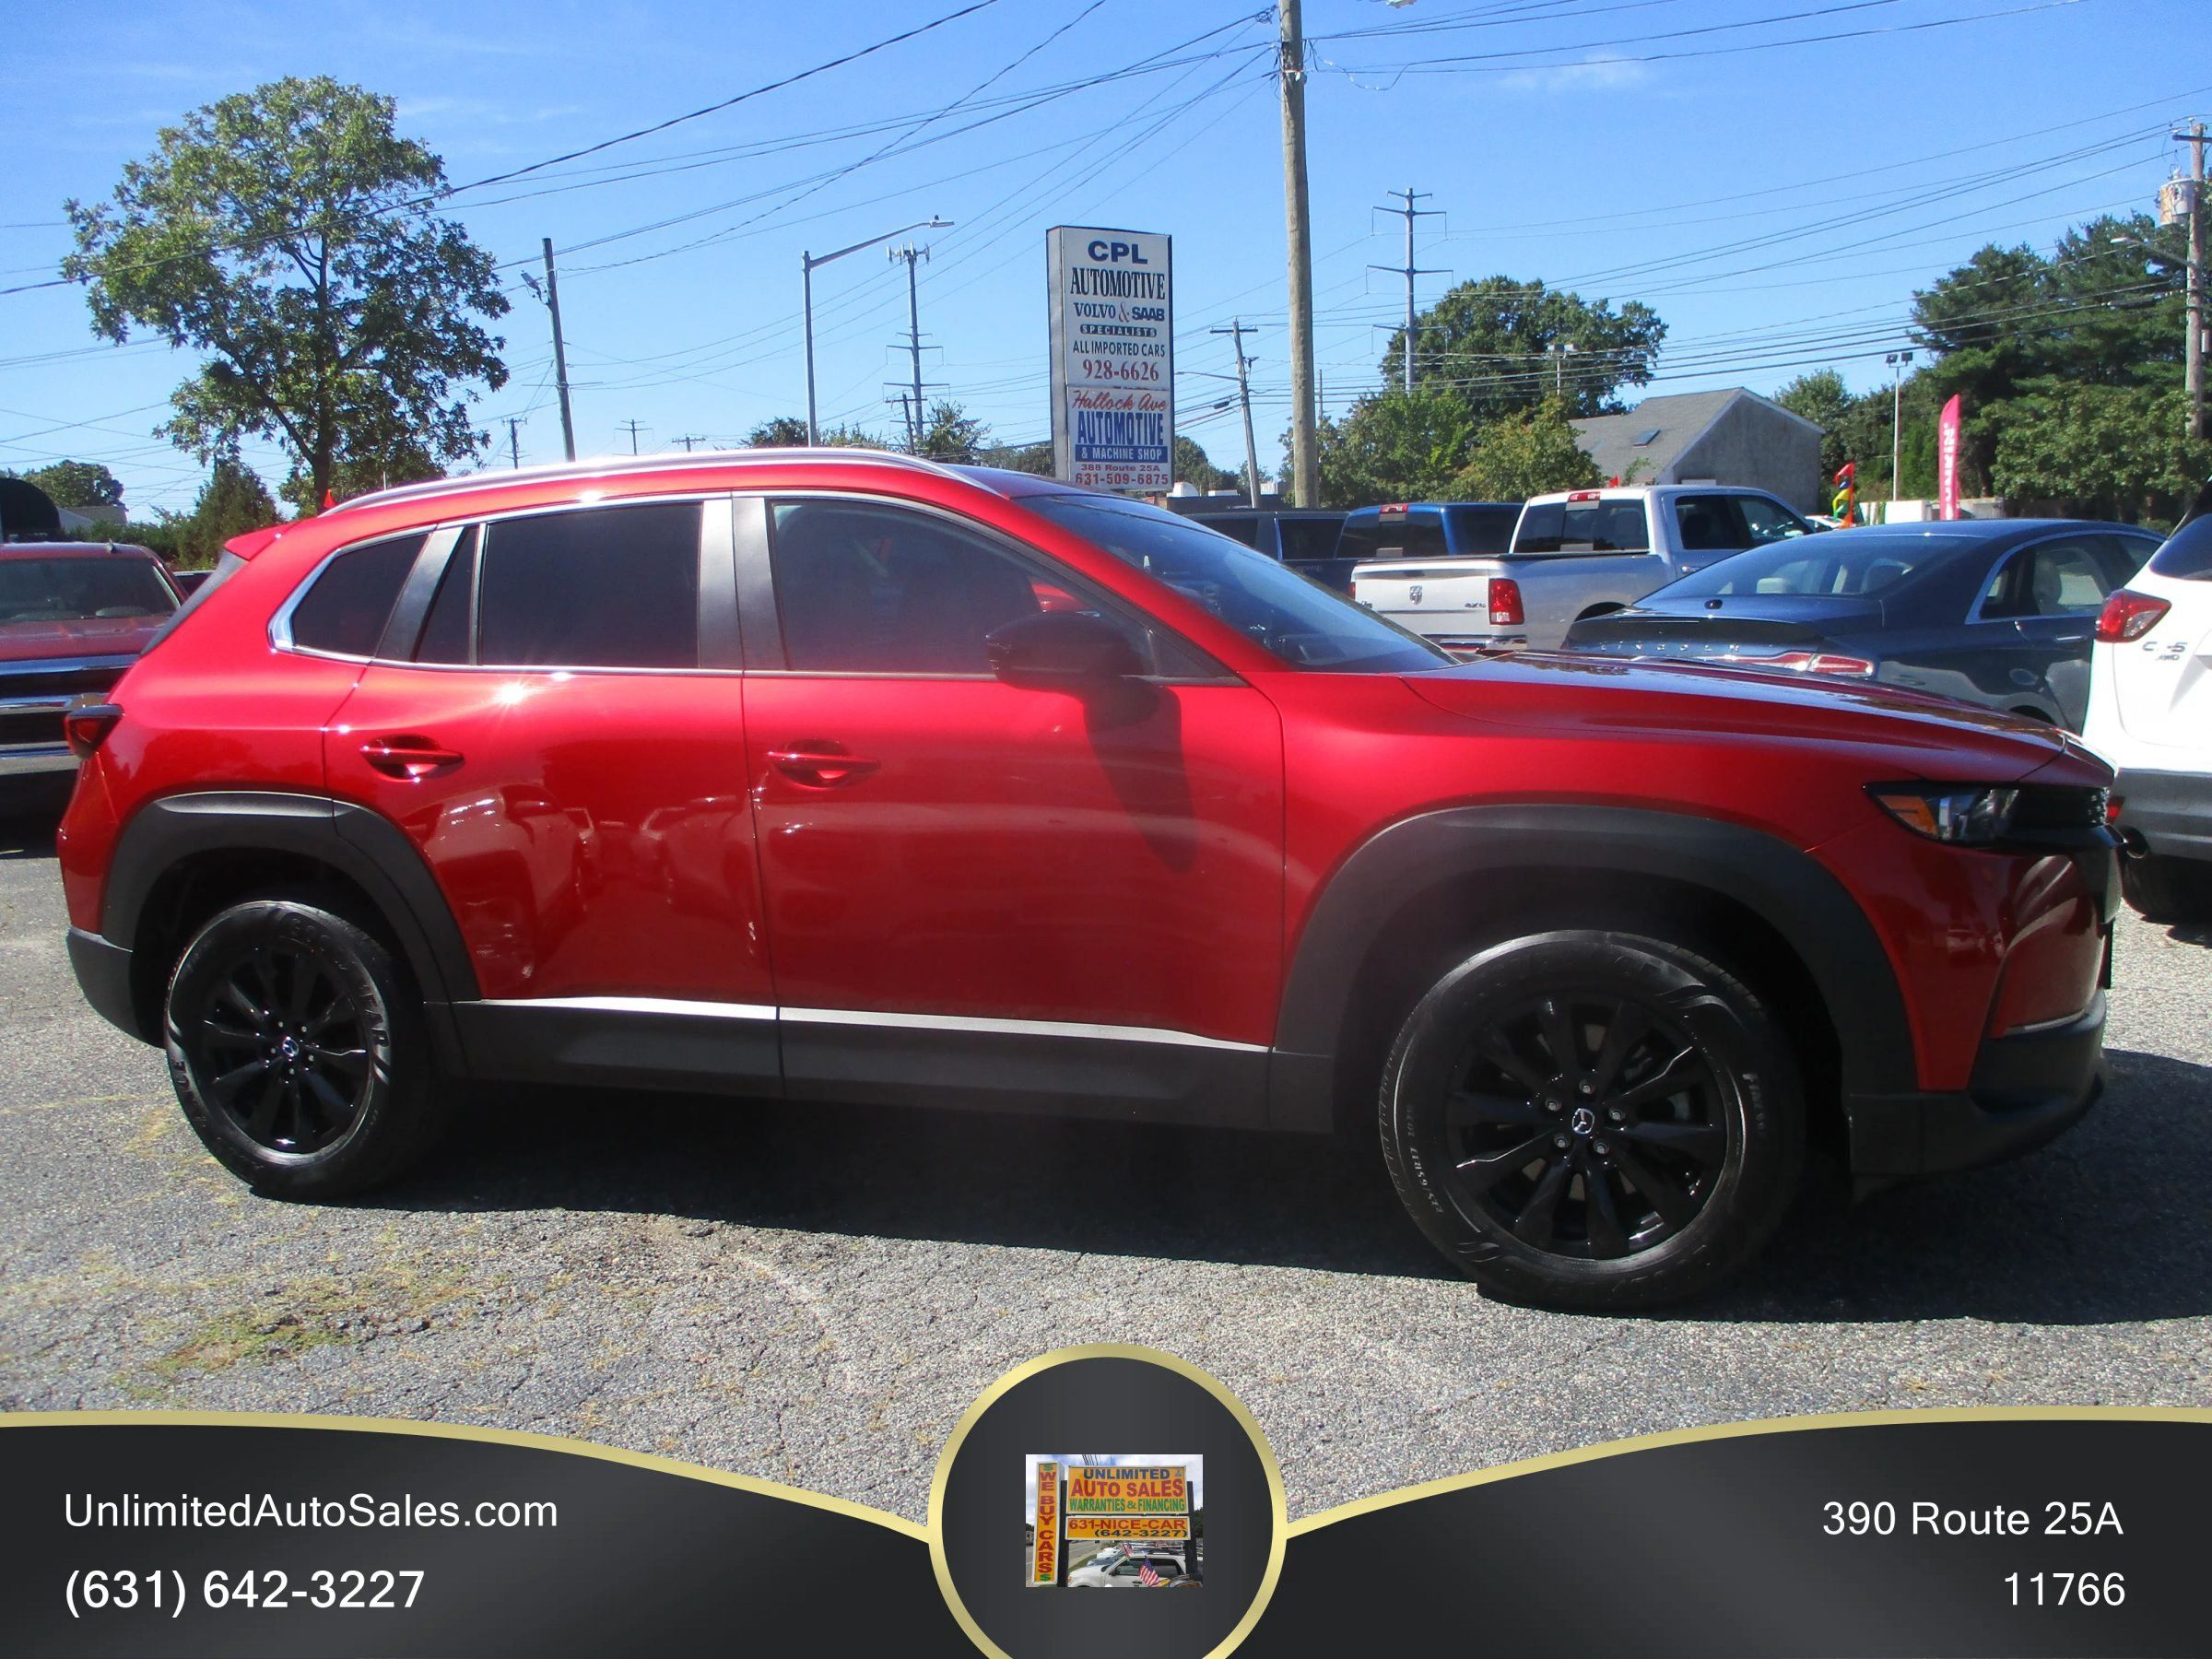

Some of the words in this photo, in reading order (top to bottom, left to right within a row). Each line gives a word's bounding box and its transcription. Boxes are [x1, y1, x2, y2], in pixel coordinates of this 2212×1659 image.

[1088, 241, 1148, 265] CPL
[1070, 267, 1166, 300] AUTOMOTIVE
[1074, 302, 1116, 319] VOLVO
[1119, 301, 1129, 323] &
[1132, 306, 1165, 322] SAAB
[1082, 324, 1157, 337] SPECIALISTS
[1073, 340, 1089, 354] ALL
[1092, 341, 1139, 356] IMPORTED
[1142, 344, 1165, 358] CARS
[1083, 359, 1159, 382] 928-6626
[1072, 390, 1134, 410] Hallock
[1138, 394, 1168, 411] Ave
[1077, 411, 1164, 445] AUTOMOTIVE
[1082, 447, 1088, 459] &
[1092, 447, 1134, 460] MACHINE
[1137, 449, 1162, 460] SHOP
[1081, 464, 1101, 472] 388
[1105, 464, 1136, 472] Route
[1076, 473, 1169, 486] 631-509-6875
[2142, 641, 2188, 653] C-5
